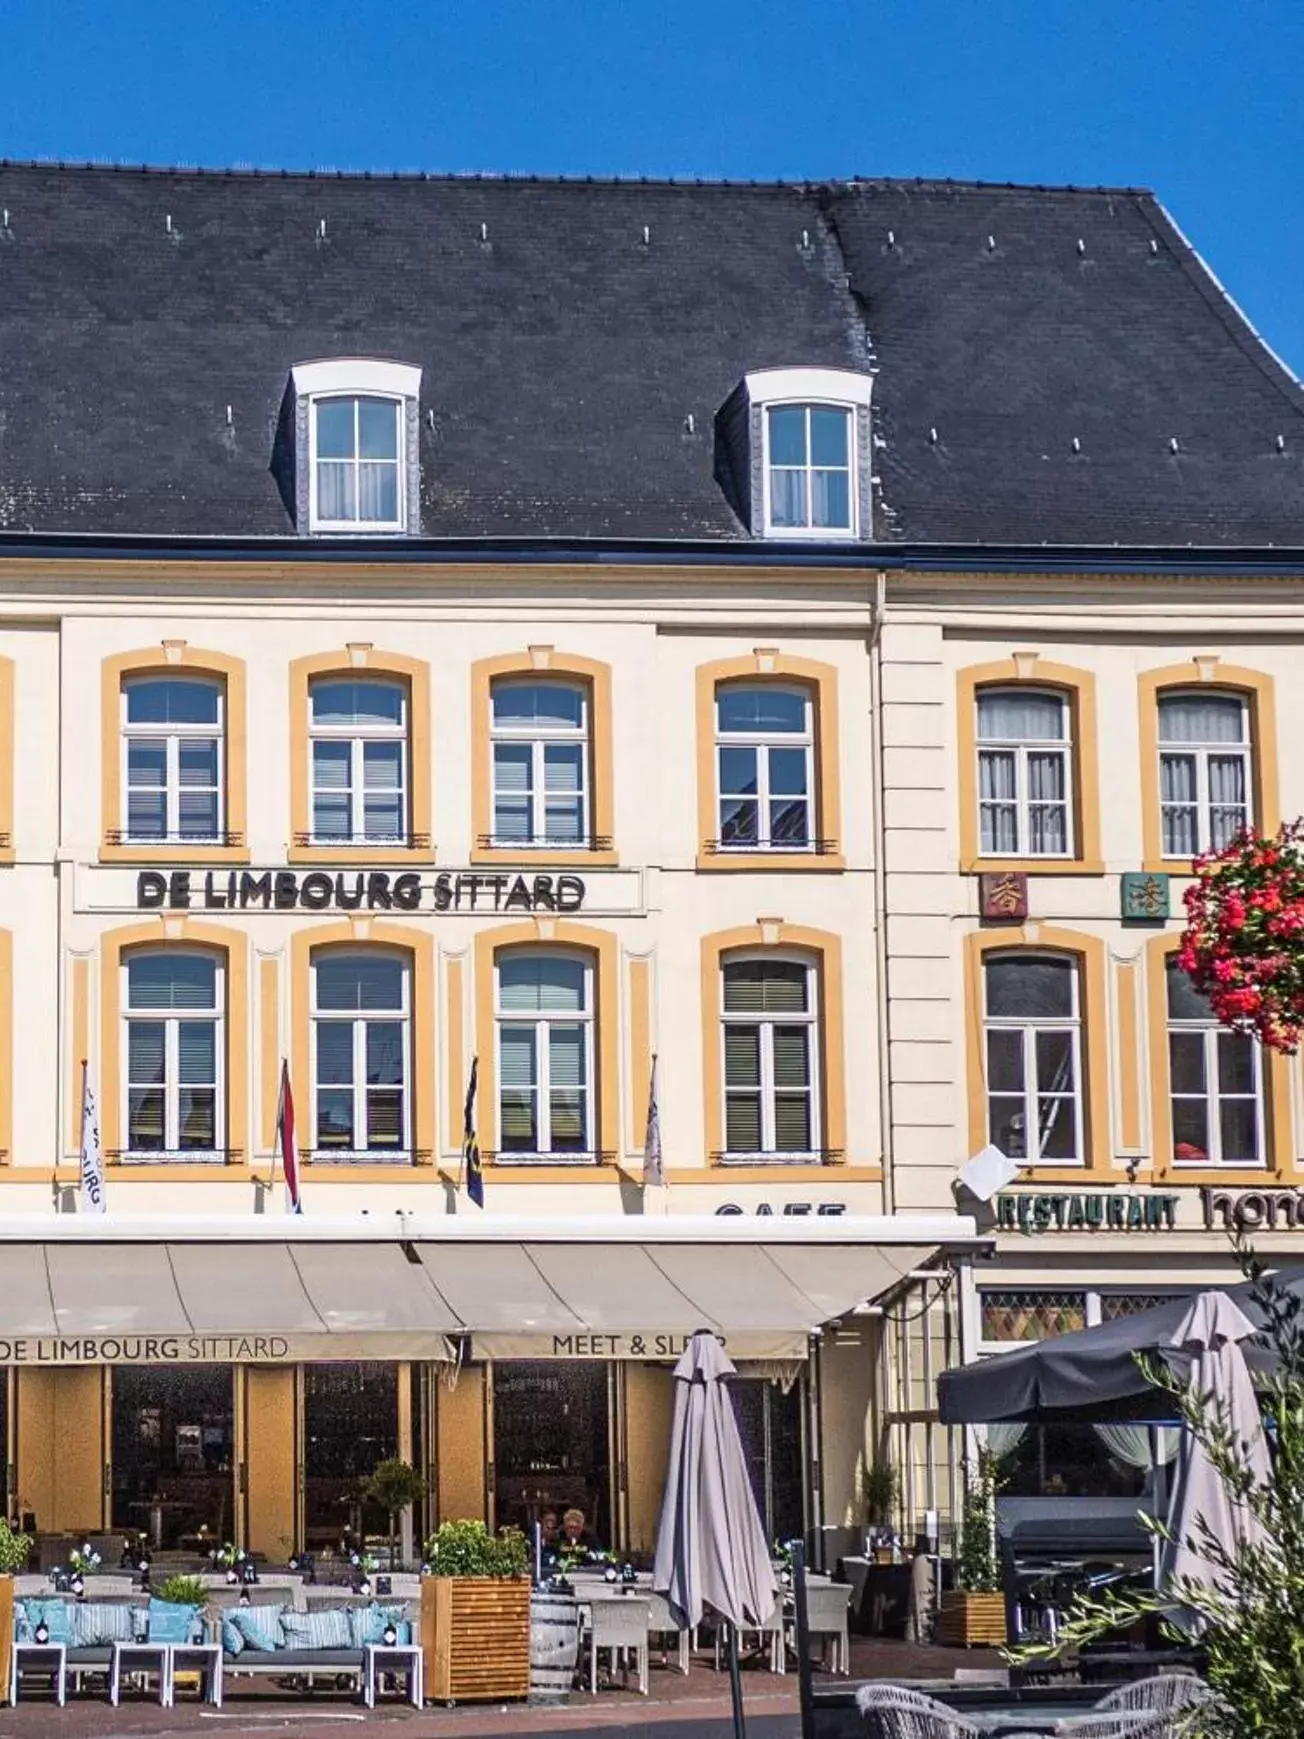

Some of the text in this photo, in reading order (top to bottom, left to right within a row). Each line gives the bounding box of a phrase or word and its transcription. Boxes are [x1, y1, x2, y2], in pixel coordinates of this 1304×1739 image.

[136, 871, 586, 912] DE LIMBOURG SITTARD
[997, 1194, 1181, 1227] RESTAURANT
[1199, 1188, 1304, 1227] hon
[37, 1339, 179, 1360] LIMBOURG
[187, 1337, 289, 1359] SITTARD
[553, 1335, 621, 1355] MEET
[630, 1334, 646, 1355] &
